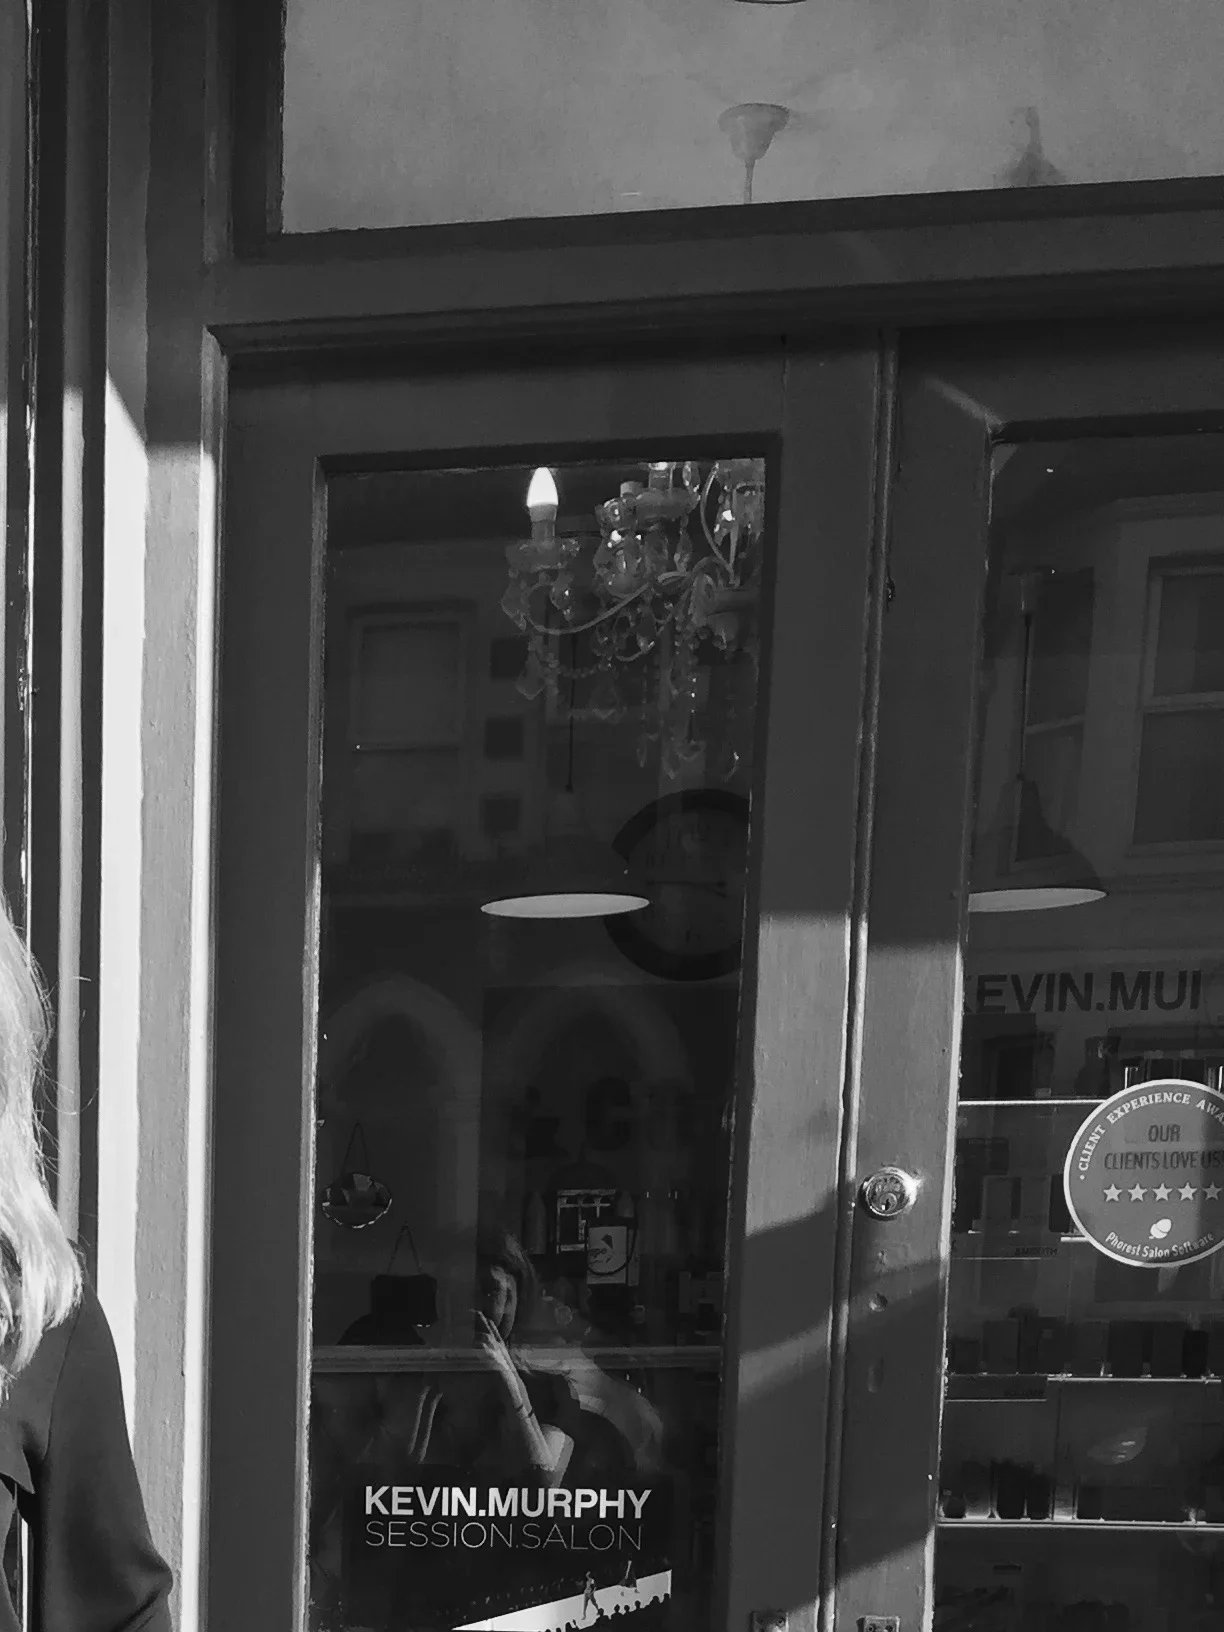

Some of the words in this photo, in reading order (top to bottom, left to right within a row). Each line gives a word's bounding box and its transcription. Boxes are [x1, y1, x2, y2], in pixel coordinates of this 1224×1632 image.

[1078, 1123, 1106, 1172] CLIENT
[1106, 1092, 1192, 1125] EXPERIENCE
[1147, 1123, 1182, 1143] OUR
[1104, 1151, 1161, 1170] CLIENTS
[1163, 1151, 1198, 1170] LOVE
[1105, 1231, 1142, 1257] Phorest
[1141, 1245, 1170, 1259] Salon
[1171, 1232, 1216, 1257] Software
[364, 1485, 652, 1519] KEVIN.MURPHY
[365, 1520, 643, 1551] SESSION.SALON
